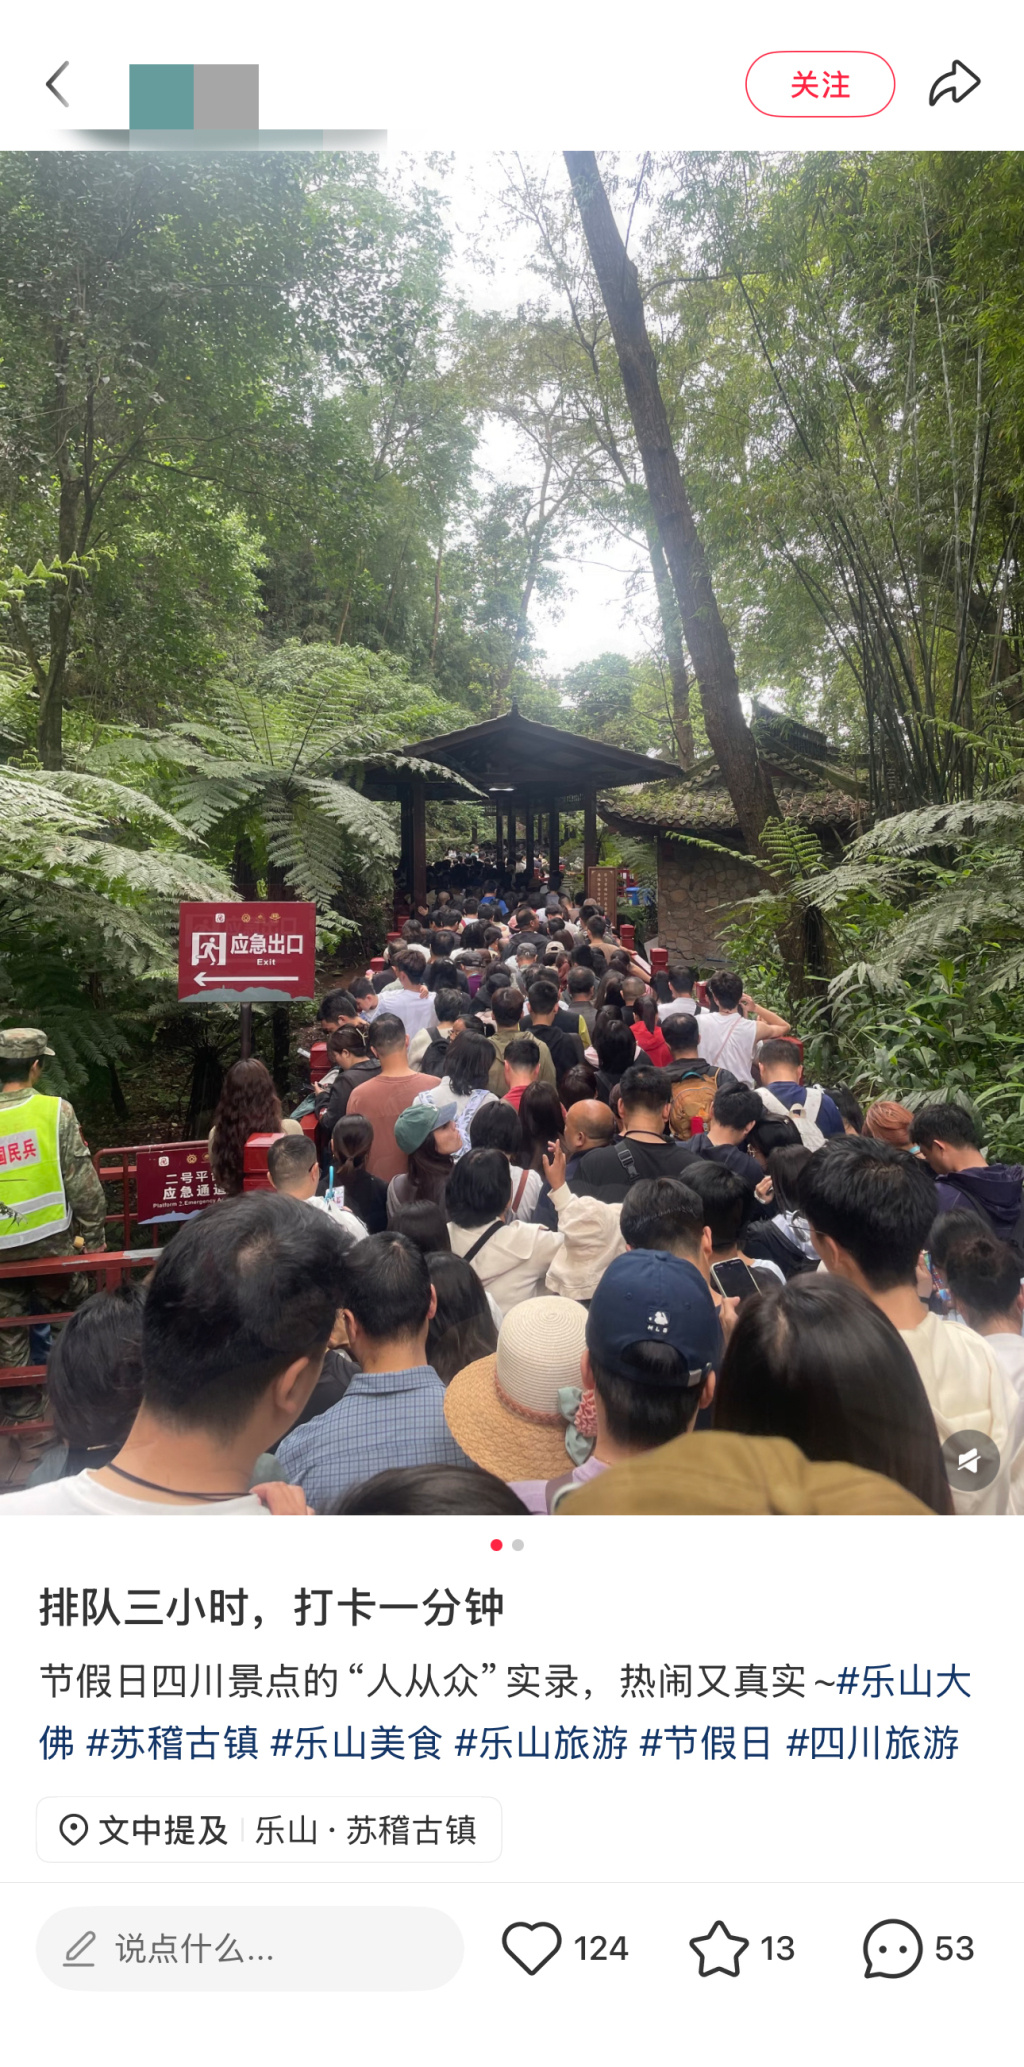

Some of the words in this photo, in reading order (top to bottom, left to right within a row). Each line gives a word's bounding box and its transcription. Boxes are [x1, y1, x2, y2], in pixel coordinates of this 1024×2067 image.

[230, 933, 304, 955] 应急出口
[256, 958, 276, 966] Exit
[152, 1201, 178, 1209] Platform
